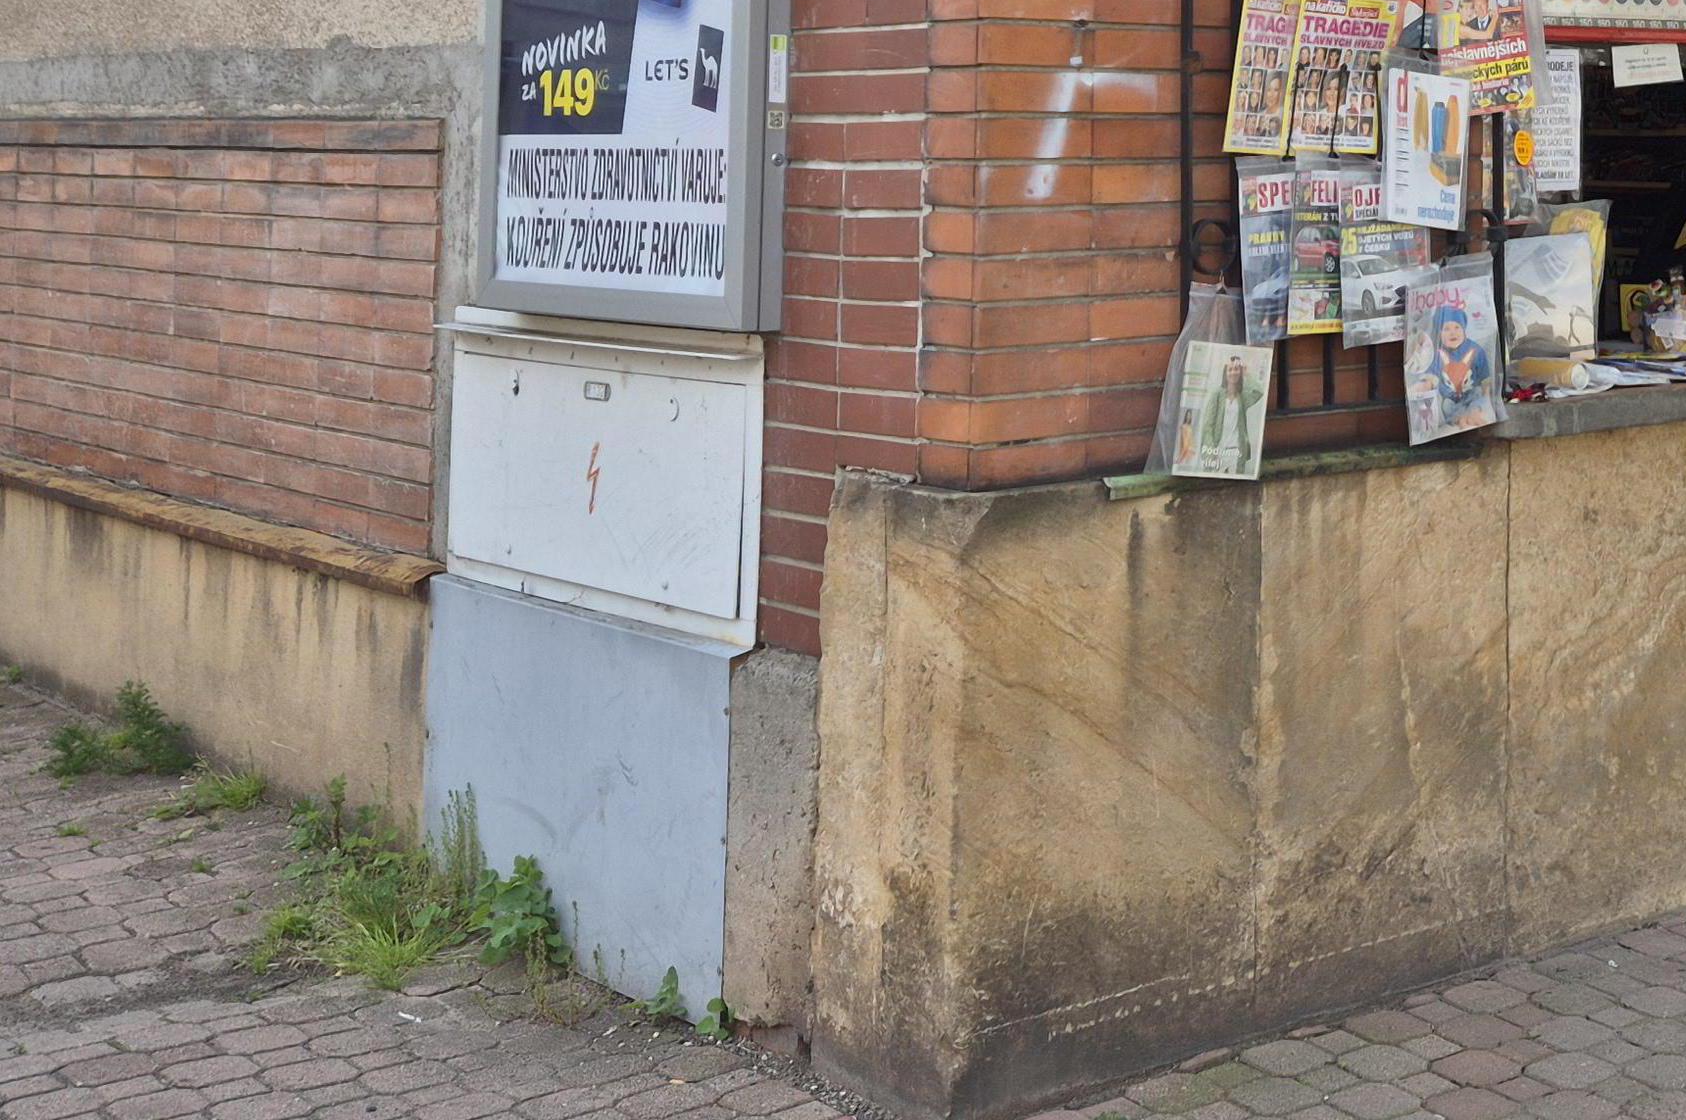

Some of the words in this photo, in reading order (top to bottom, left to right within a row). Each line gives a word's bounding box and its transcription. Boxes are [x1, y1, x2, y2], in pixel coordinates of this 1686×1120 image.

[521, 20, 606, 76] NOVINKA
[644, 57, 690, 81] LET'S
[521, 82, 537, 101] ZA
[539, 67, 596, 117] 149
[595, 68, 610, 92] Kč
[506, 147, 589, 201] MINISTERSTVO
[590, 137, 681, 203] ZDRAVOTNICTVÍ
[681, 147, 727, 205] VARUJE:
[506, 207, 568, 270] KOUŘENÍ
[562, 206, 648, 276] ZPŮSOBUJE
[648, 220, 726, 281] RAKOVINU
